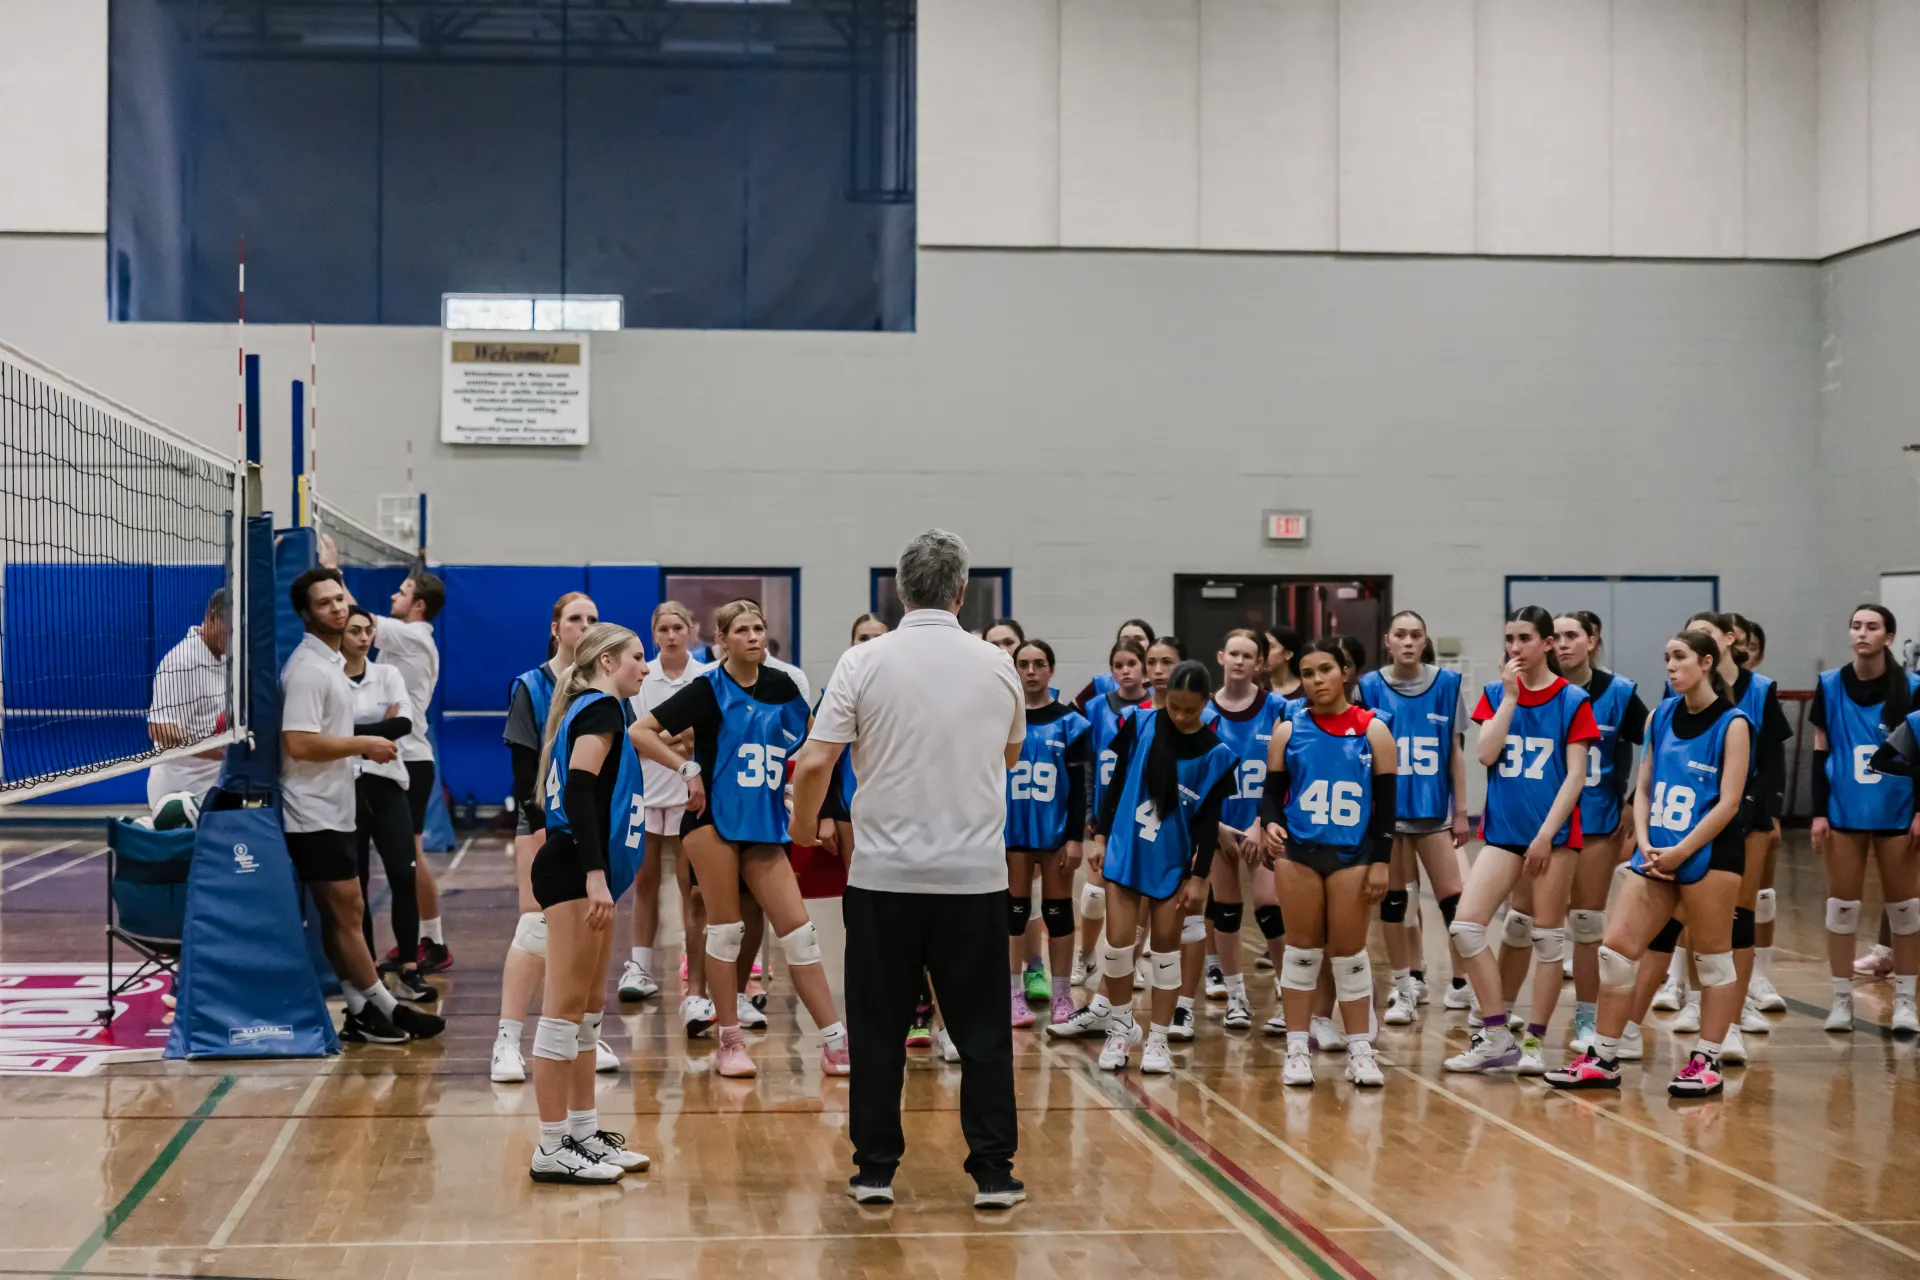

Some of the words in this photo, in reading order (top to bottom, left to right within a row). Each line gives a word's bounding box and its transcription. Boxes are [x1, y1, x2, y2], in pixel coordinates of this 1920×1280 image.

[475, 344, 559, 363] Welcome!
[1275, 516, 1300, 537] EXIT
[737, 743, 787, 791] 35
[1396, 736, 1440, 776] 15
[1499, 734, 1554, 780] 37
[1009, 760, 1058, 803] 29
[1300, 779, 1363, 827] 46
